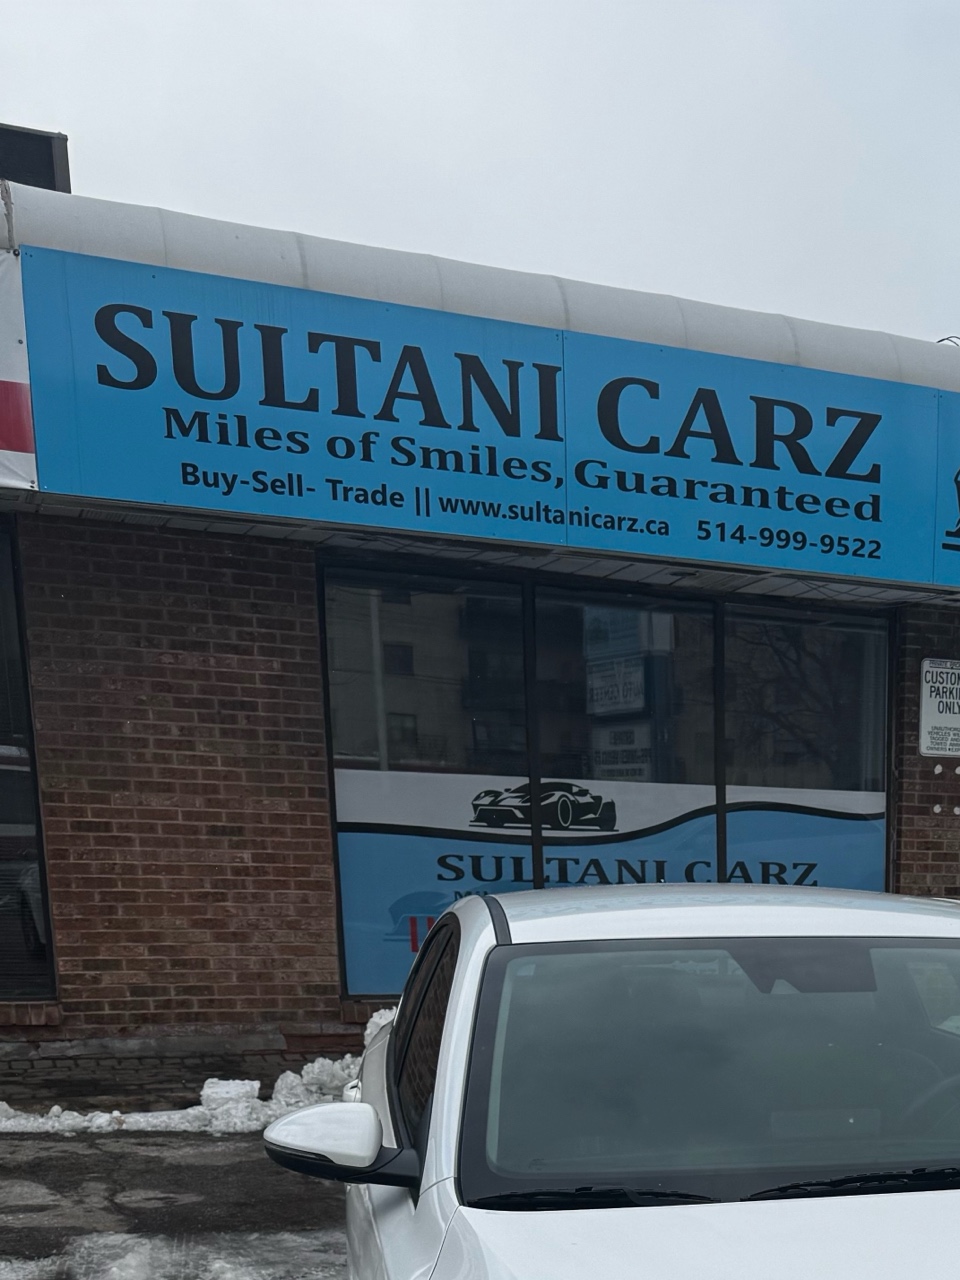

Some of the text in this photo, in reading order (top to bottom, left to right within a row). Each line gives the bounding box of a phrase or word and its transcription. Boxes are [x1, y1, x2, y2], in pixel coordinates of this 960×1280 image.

[94, 303, 883, 484] SULTANI CARZ
[161, 406, 883, 523] Miles of Smiles, Guaranteed
[324, 478, 405, 508] Trade
[438, 496, 671, 537] www.sultanicarz.ca
[697, 519, 882, 560] 514-999-9522
[436, 853, 819, 887] SULTANI CARZ
